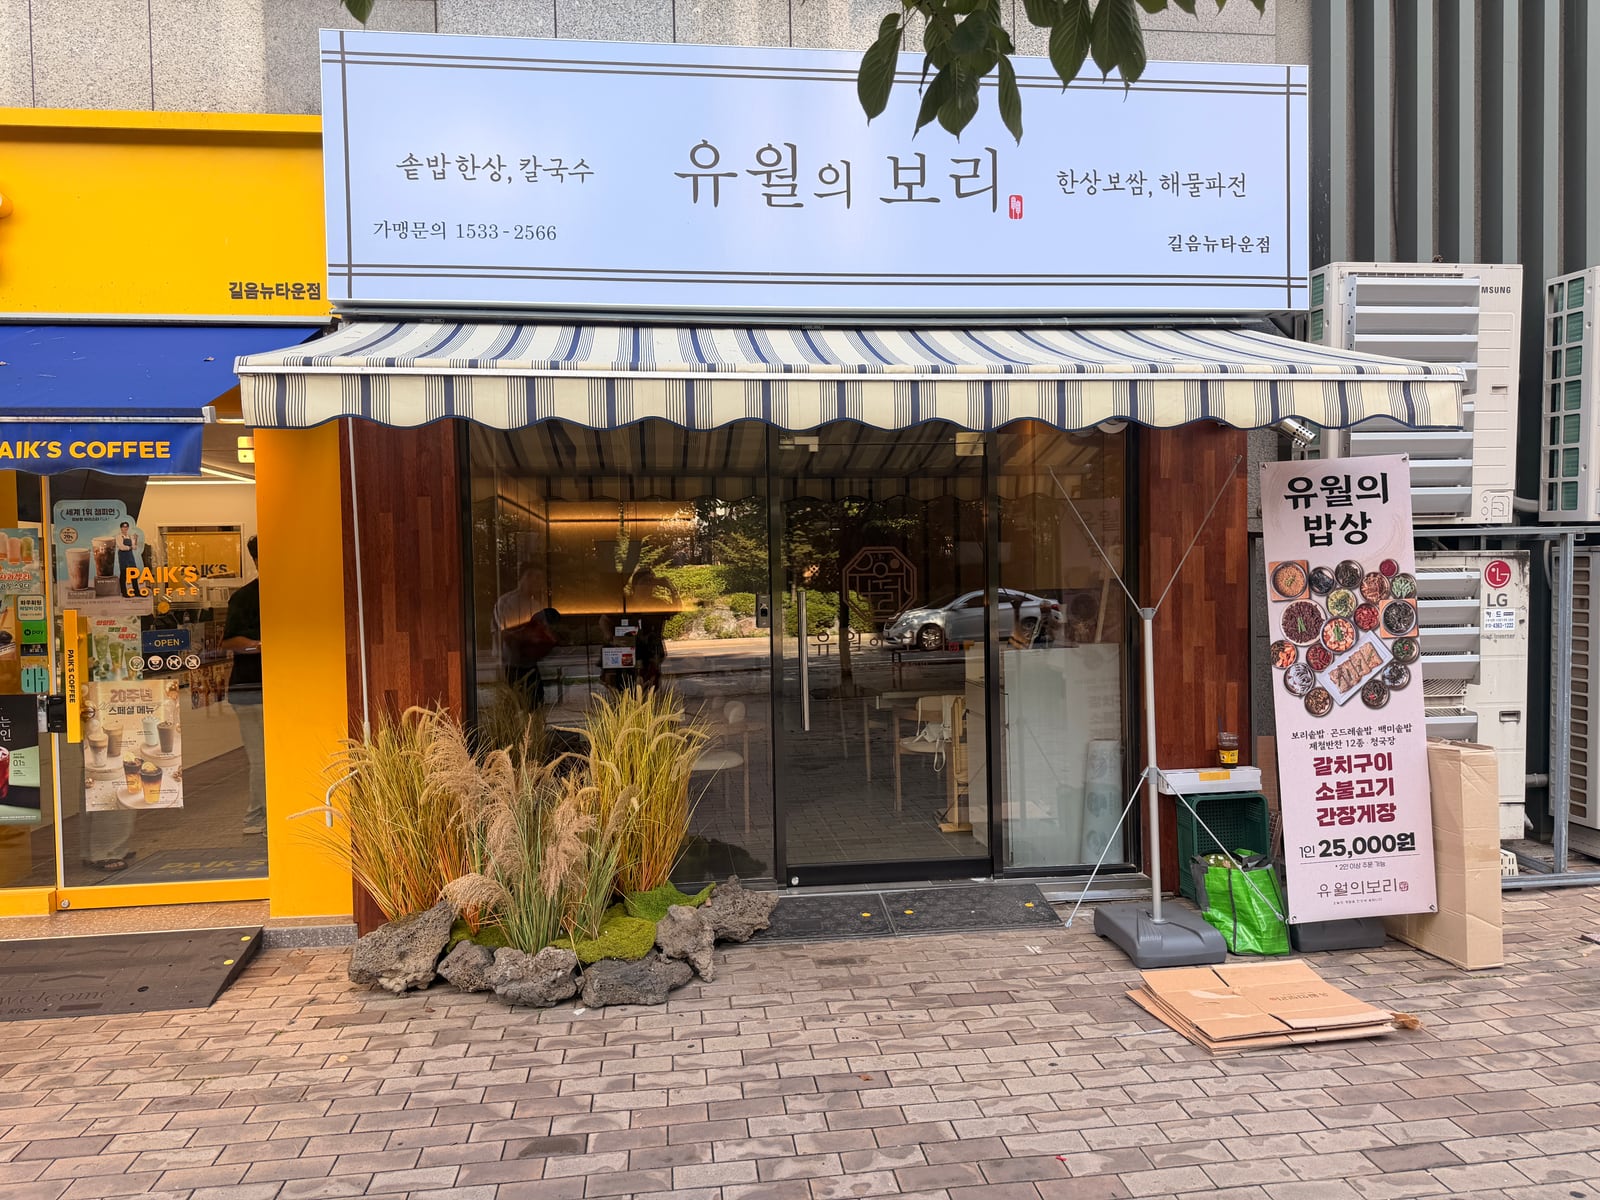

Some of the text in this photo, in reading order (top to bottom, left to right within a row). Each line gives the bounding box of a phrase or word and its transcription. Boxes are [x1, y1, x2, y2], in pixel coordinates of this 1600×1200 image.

[519, 155, 594, 184] 칼국수
[674, 139, 998, 212] 유월의 보리
[1159, 171, 1247, 199] 해물파전
[373, 219, 447, 241] 가맹문의
[1167, 234, 1270, 254] 길음뉴타운점
[229, 281, 321, 300] 길음뉴타운점
[1481, 286, 1511, 294] MSUNG
[0, 441, 170, 459] AIK'S COFFEE
[1284, 472, 1389, 510] 유월의
[1303, 511, 1372, 547] 밥상
[126, 567, 198, 583] PAIK'S
[127, 587, 198, 597] COFFEE
[1487, 593, 1508, 607] LG
[154, 639, 180, 648] OPEN
[110, 688, 153, 703] 20주년
[108, 705, 155, 716] 스페셜 메뉴
[1291, 723, 1412, 740] 보리솥밥 곤드레솥밥 백미솥밥
[1309, 736, 1396, 751] 제철반찬 12종 청국장
[1313, 752, 1393, 776] 갈치구이
[1315, 777, 1395, 801] 소불고기
[1316, 803, 1397, 827] 간장게장
[1299, 832, 1416, 859] 1인 25,000원
[1317, 878, 1397, 898] 유월의보리
